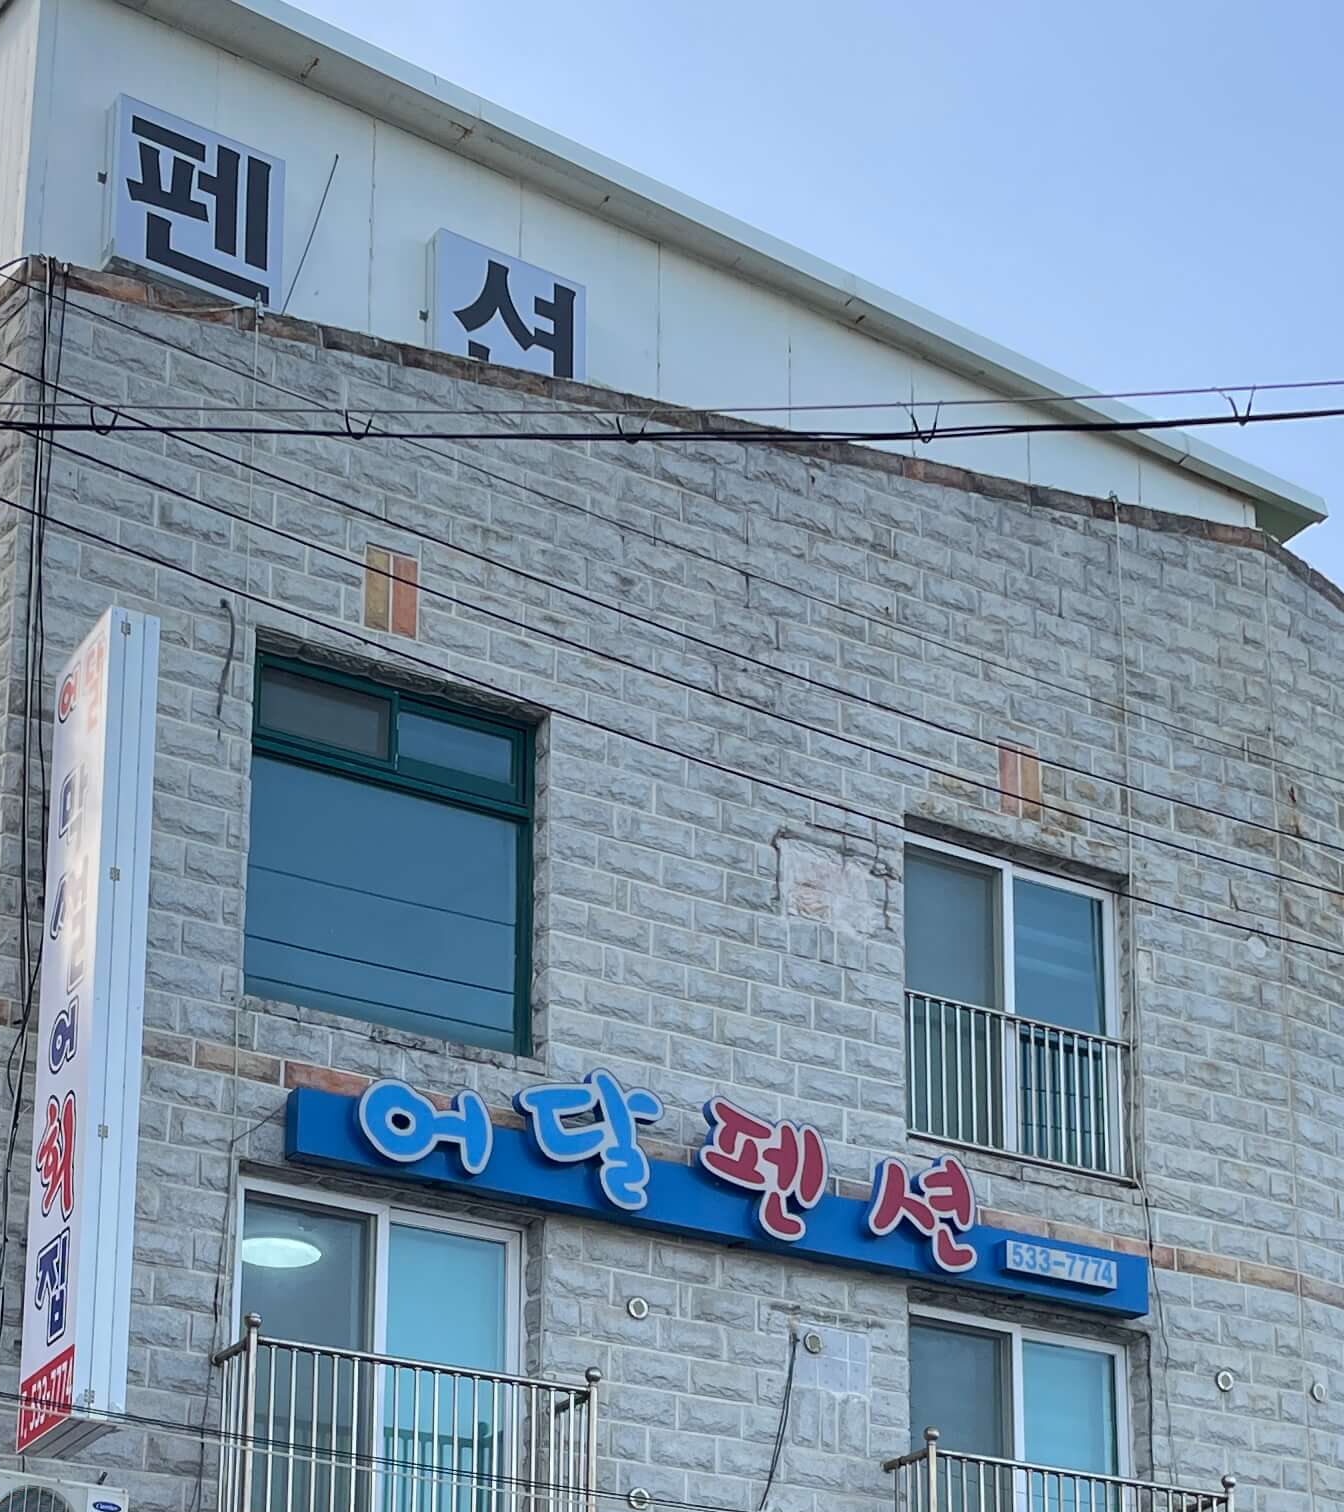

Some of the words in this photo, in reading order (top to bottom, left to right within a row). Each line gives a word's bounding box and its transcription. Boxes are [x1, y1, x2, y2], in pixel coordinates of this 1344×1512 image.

[355, 1066, 665, 1213] 어달
[698, 1094, 979, 1274] 펜션
[1009, 1243, 1117, 1288] 533-7774
